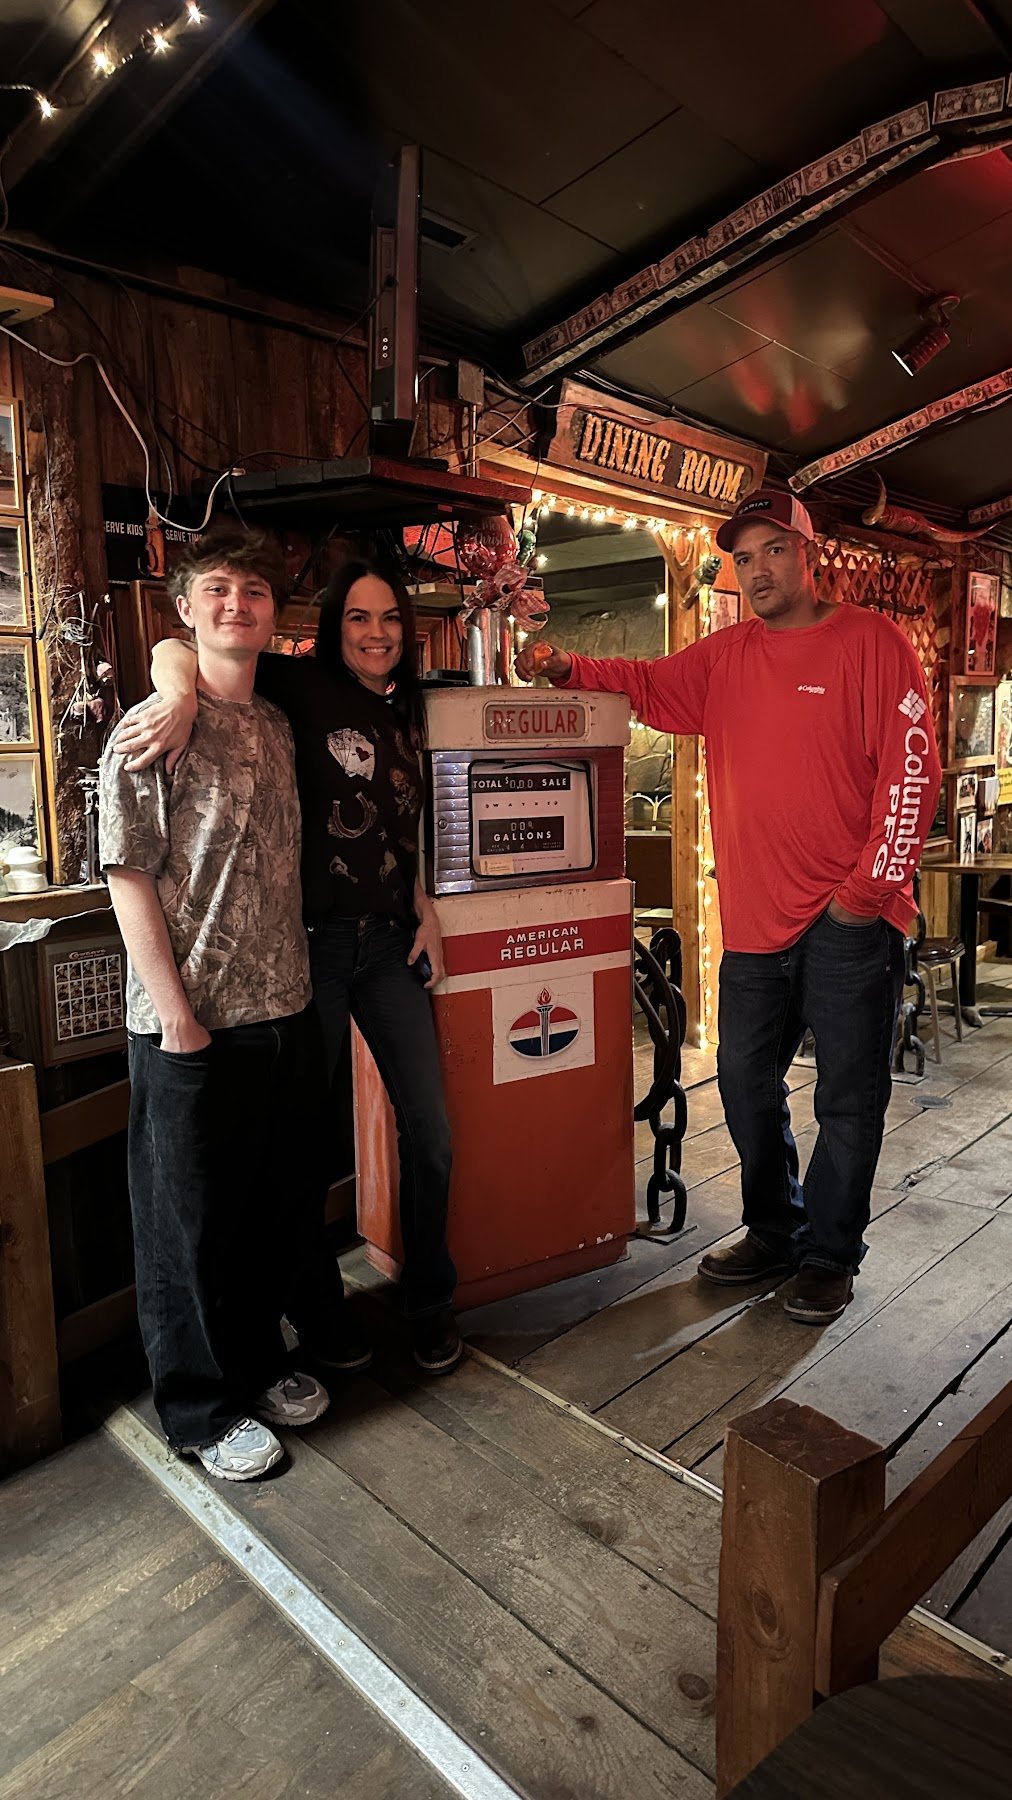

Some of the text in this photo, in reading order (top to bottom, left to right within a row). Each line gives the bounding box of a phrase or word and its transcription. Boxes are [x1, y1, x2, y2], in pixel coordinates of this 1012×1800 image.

[580, 413, 745, 503] DINING ROOM
[105, 520, 144, 536] ERVE KIDS
[165, 529, 187, 543] SERVE
[492, 709, 578, 734] REGULAR
[473, 780, 502, 789] TOTAL
[541, 778, 567, 787] SALE
[886, 726, 930, 882] Columbia
[493, 831, 552, 842] GALLONS
[872, 783, 900, 879] PFG
[506, 926, 579, 945] AMERICAN
[500, 938, 584, 961] REGULAR
